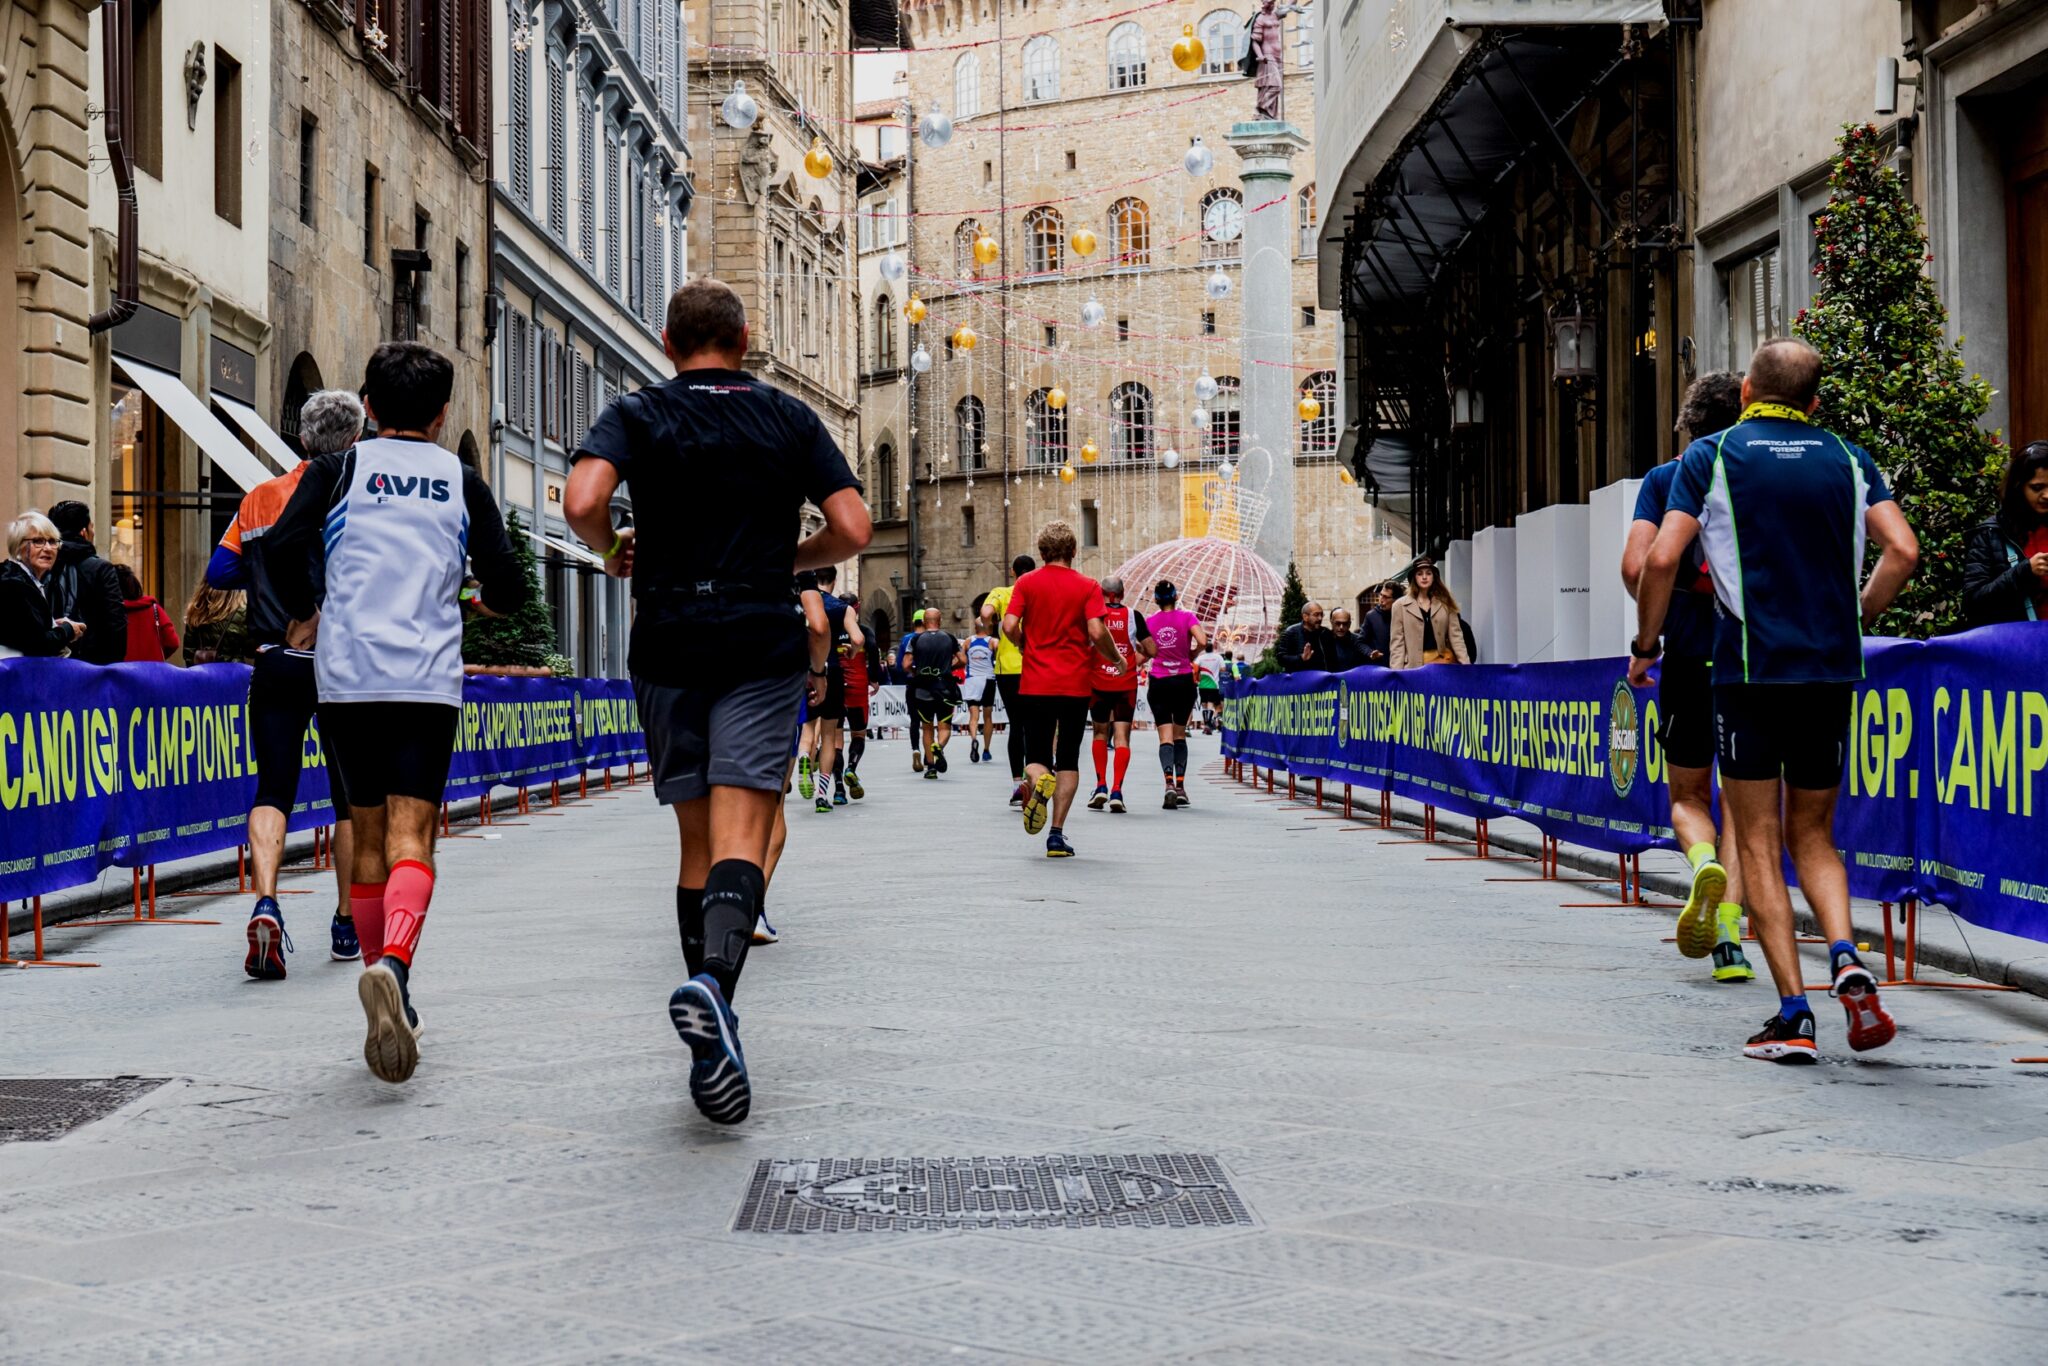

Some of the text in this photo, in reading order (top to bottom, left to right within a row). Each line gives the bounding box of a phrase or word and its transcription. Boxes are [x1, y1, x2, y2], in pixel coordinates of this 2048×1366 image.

[366, 472, 450, 503] AVIS
[128, 704, 242, 791] CAMPIONE
[1349, 690, 1368, 741] OLIO
[1368, 690, 1410, 746] TOSCANO
[1428, 694, 1489, 762] CAMPIONE
[1491, 699, 1508, 766] DI
[1510, 700, 1605, 779] BENESSERE.
[1611, 721, 1636, 750] Toscano
[1849, 686, 2048, 817] IGP. CAMP
